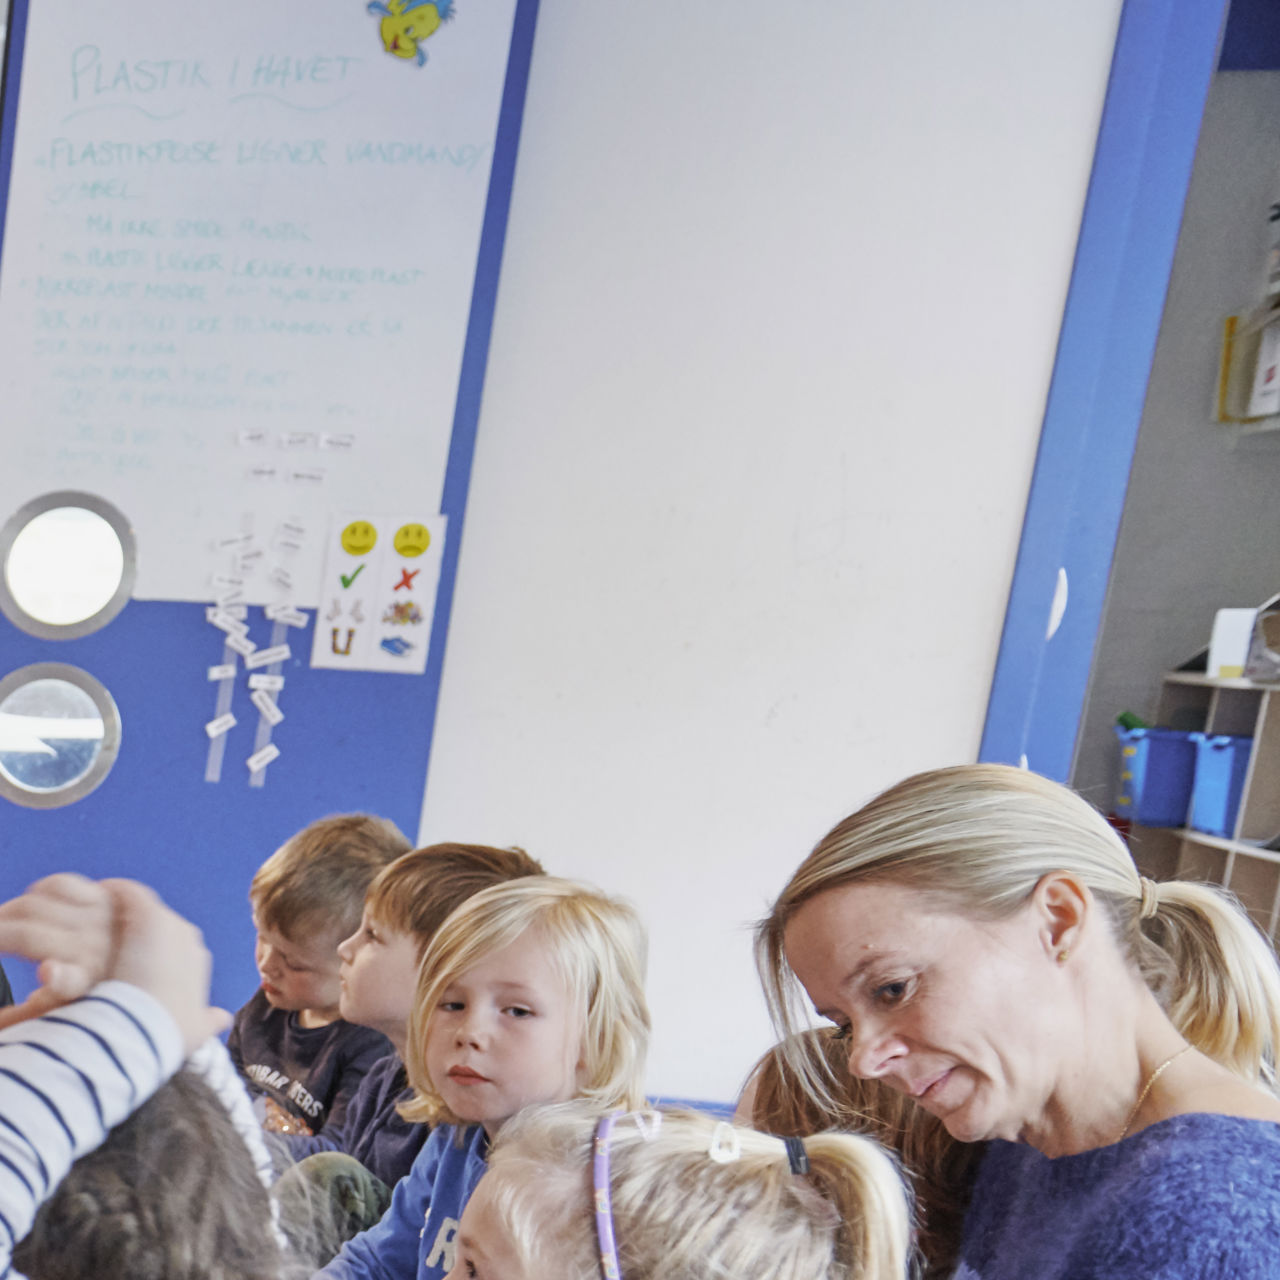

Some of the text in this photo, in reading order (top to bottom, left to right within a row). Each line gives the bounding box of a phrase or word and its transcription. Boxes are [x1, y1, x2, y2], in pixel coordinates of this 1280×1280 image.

[70, 44, 364, 101] PLASTIK I HAVET
